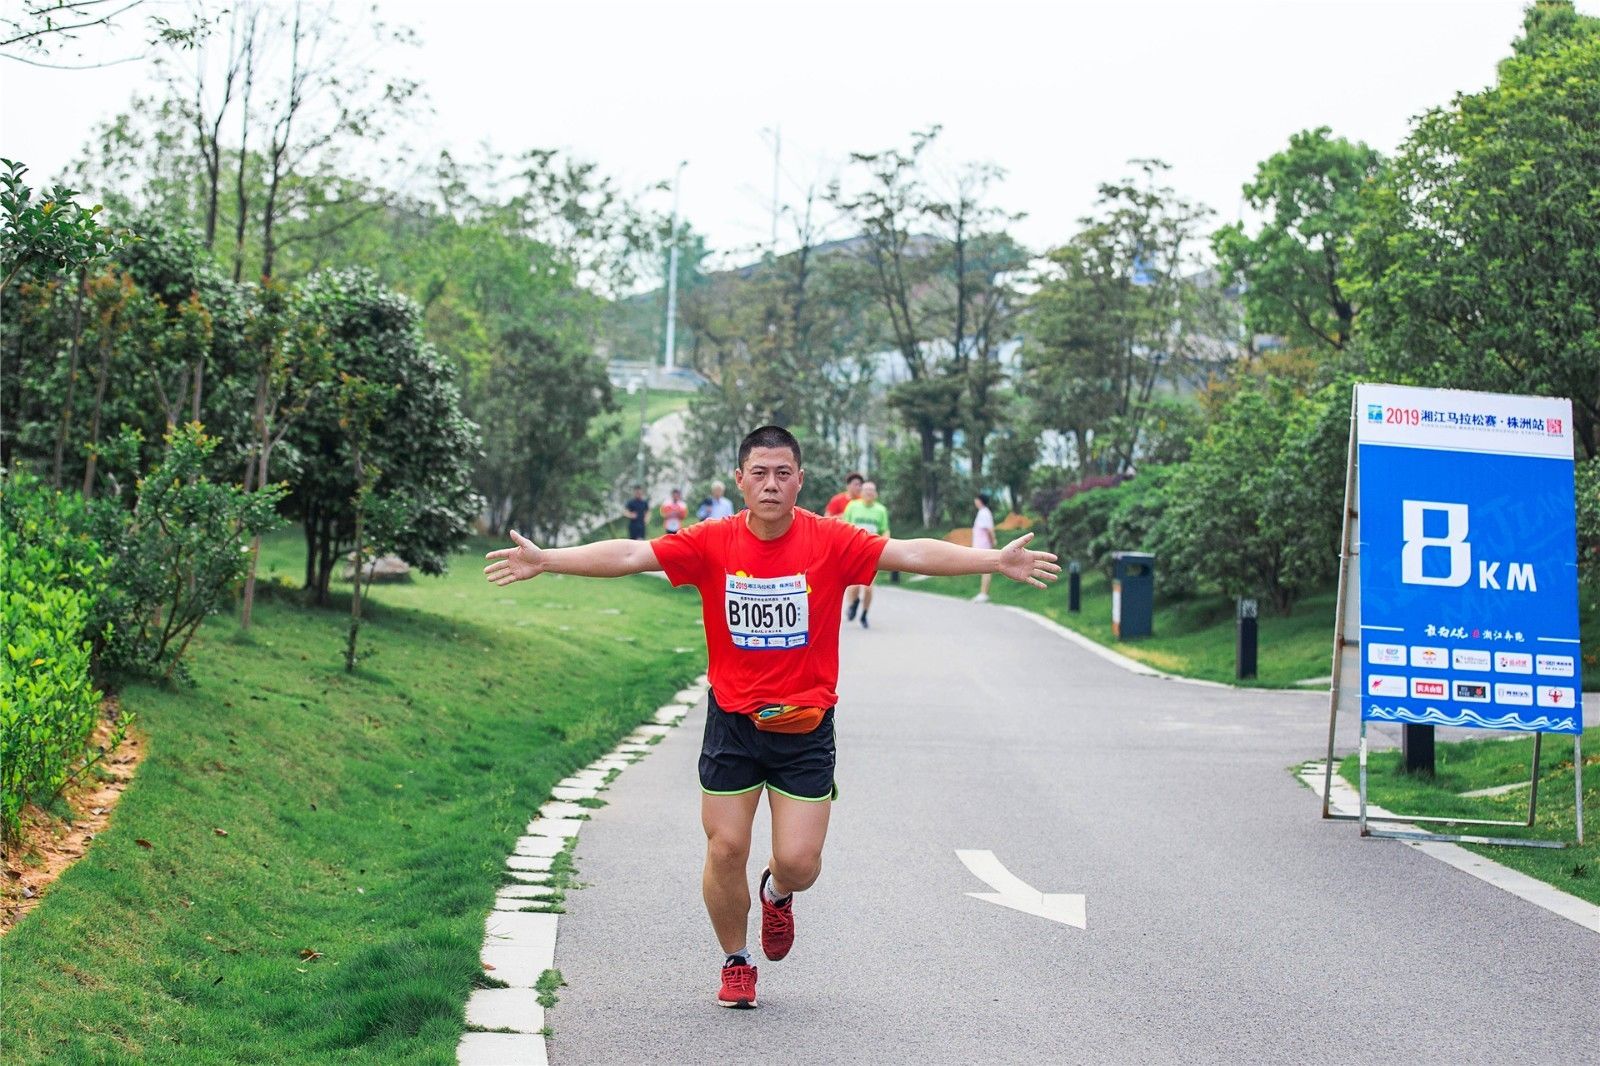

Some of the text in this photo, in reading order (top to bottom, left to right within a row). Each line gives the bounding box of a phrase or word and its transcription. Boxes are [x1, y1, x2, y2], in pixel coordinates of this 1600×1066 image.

[1402, 500, 1538, 593] 8 KM
[729, 600, 797, 628] B10510
